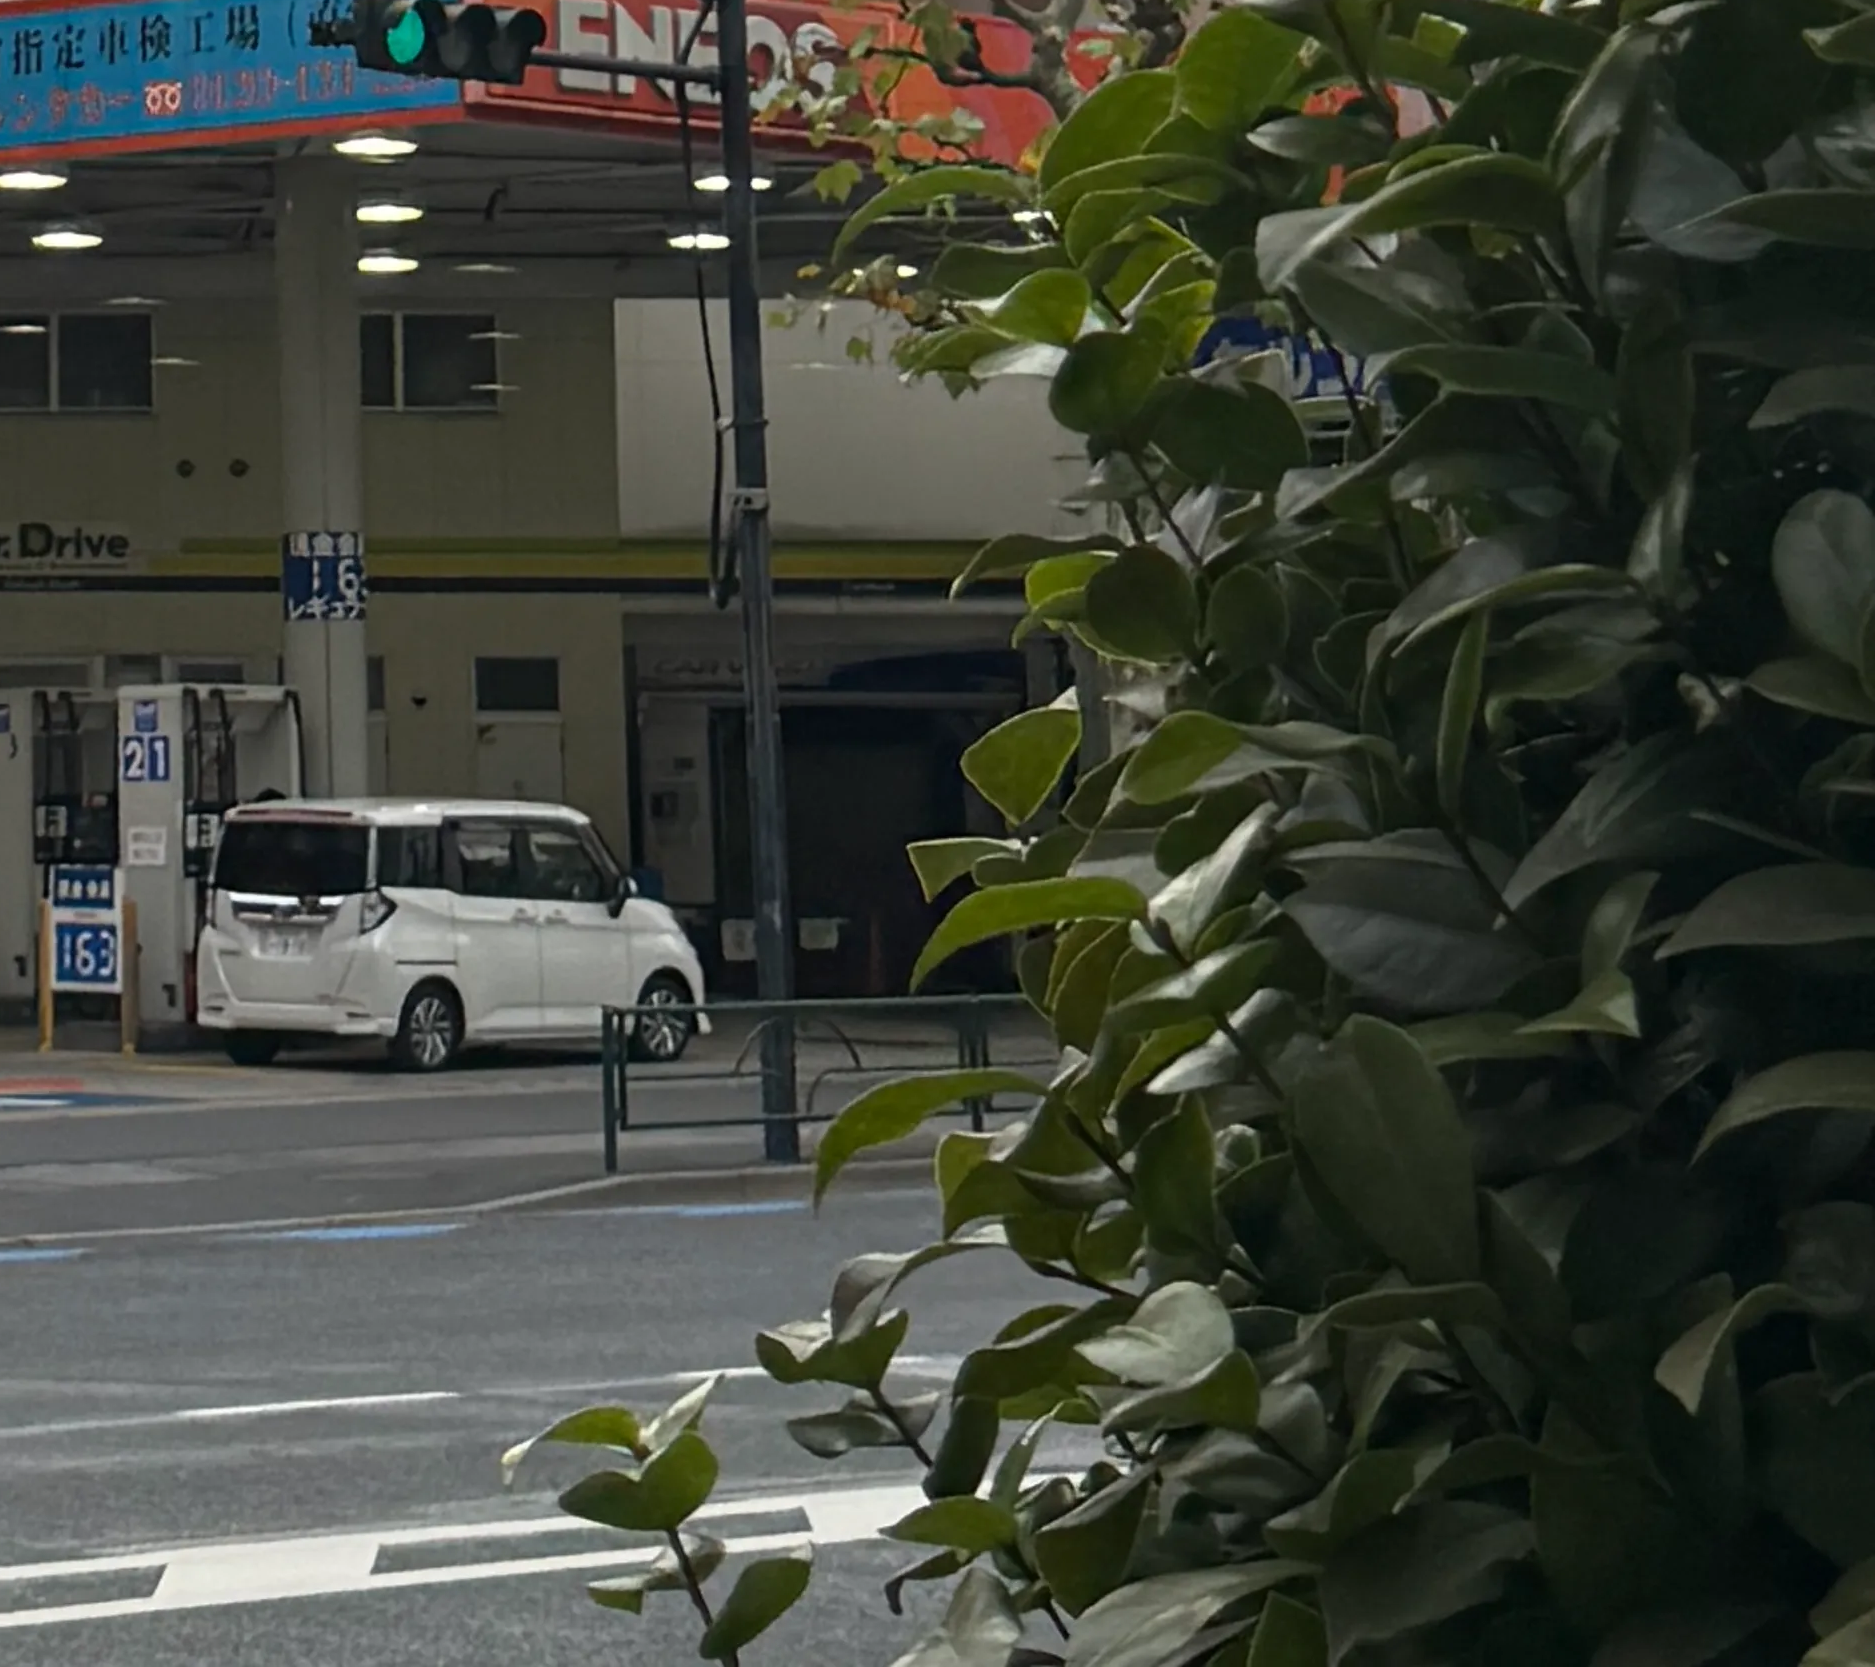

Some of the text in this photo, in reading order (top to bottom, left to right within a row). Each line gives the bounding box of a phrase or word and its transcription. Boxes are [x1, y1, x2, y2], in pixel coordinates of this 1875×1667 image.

[312, 558, 369, 598] 16
[124, 740, 166, 779] 21
[63, 931, 115, 977] 163
